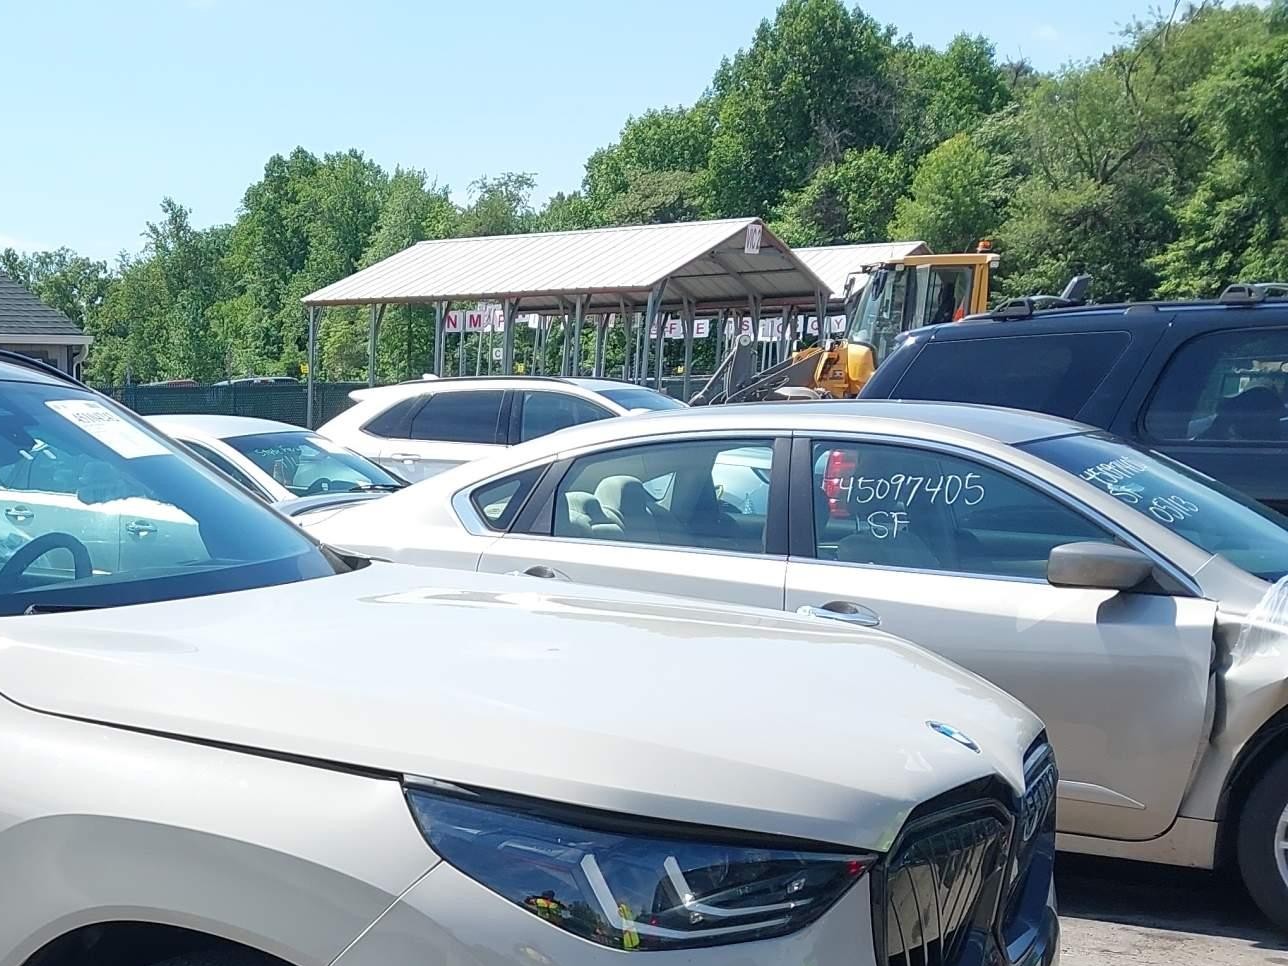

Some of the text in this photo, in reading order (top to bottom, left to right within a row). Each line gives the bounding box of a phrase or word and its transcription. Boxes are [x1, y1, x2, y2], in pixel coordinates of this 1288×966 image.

[447, 314, 458, 328] N
[469, 313, 482, 328] M
[839, 472, 985, 507] 45097405
[867, 510, 911, 539] SF
